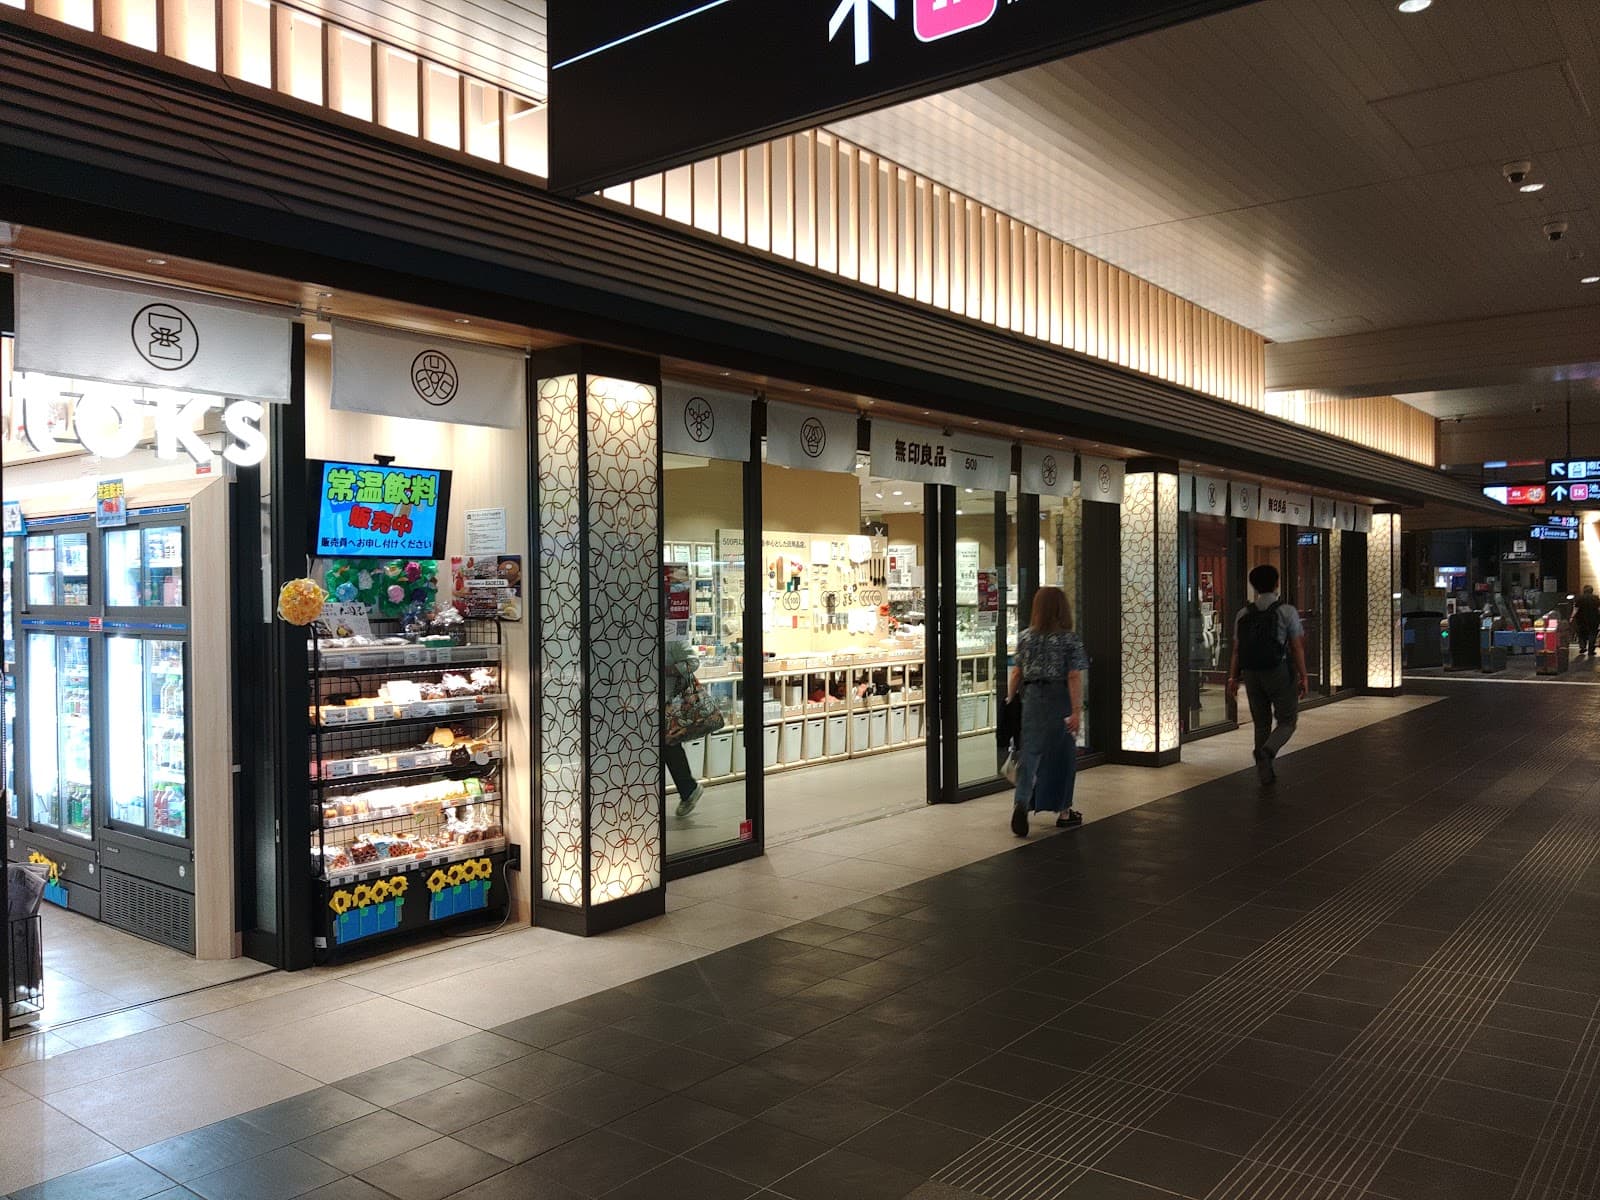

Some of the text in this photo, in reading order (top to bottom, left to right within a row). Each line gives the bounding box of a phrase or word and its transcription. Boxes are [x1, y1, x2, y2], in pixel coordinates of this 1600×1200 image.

[894, 437, 948, 467] 無印良品
[327, 468, 437, 507] 常温飲料
[348, 504, 413, 537] 販売中
[320, 537, 433, 550] 販売員へお申し付けください
